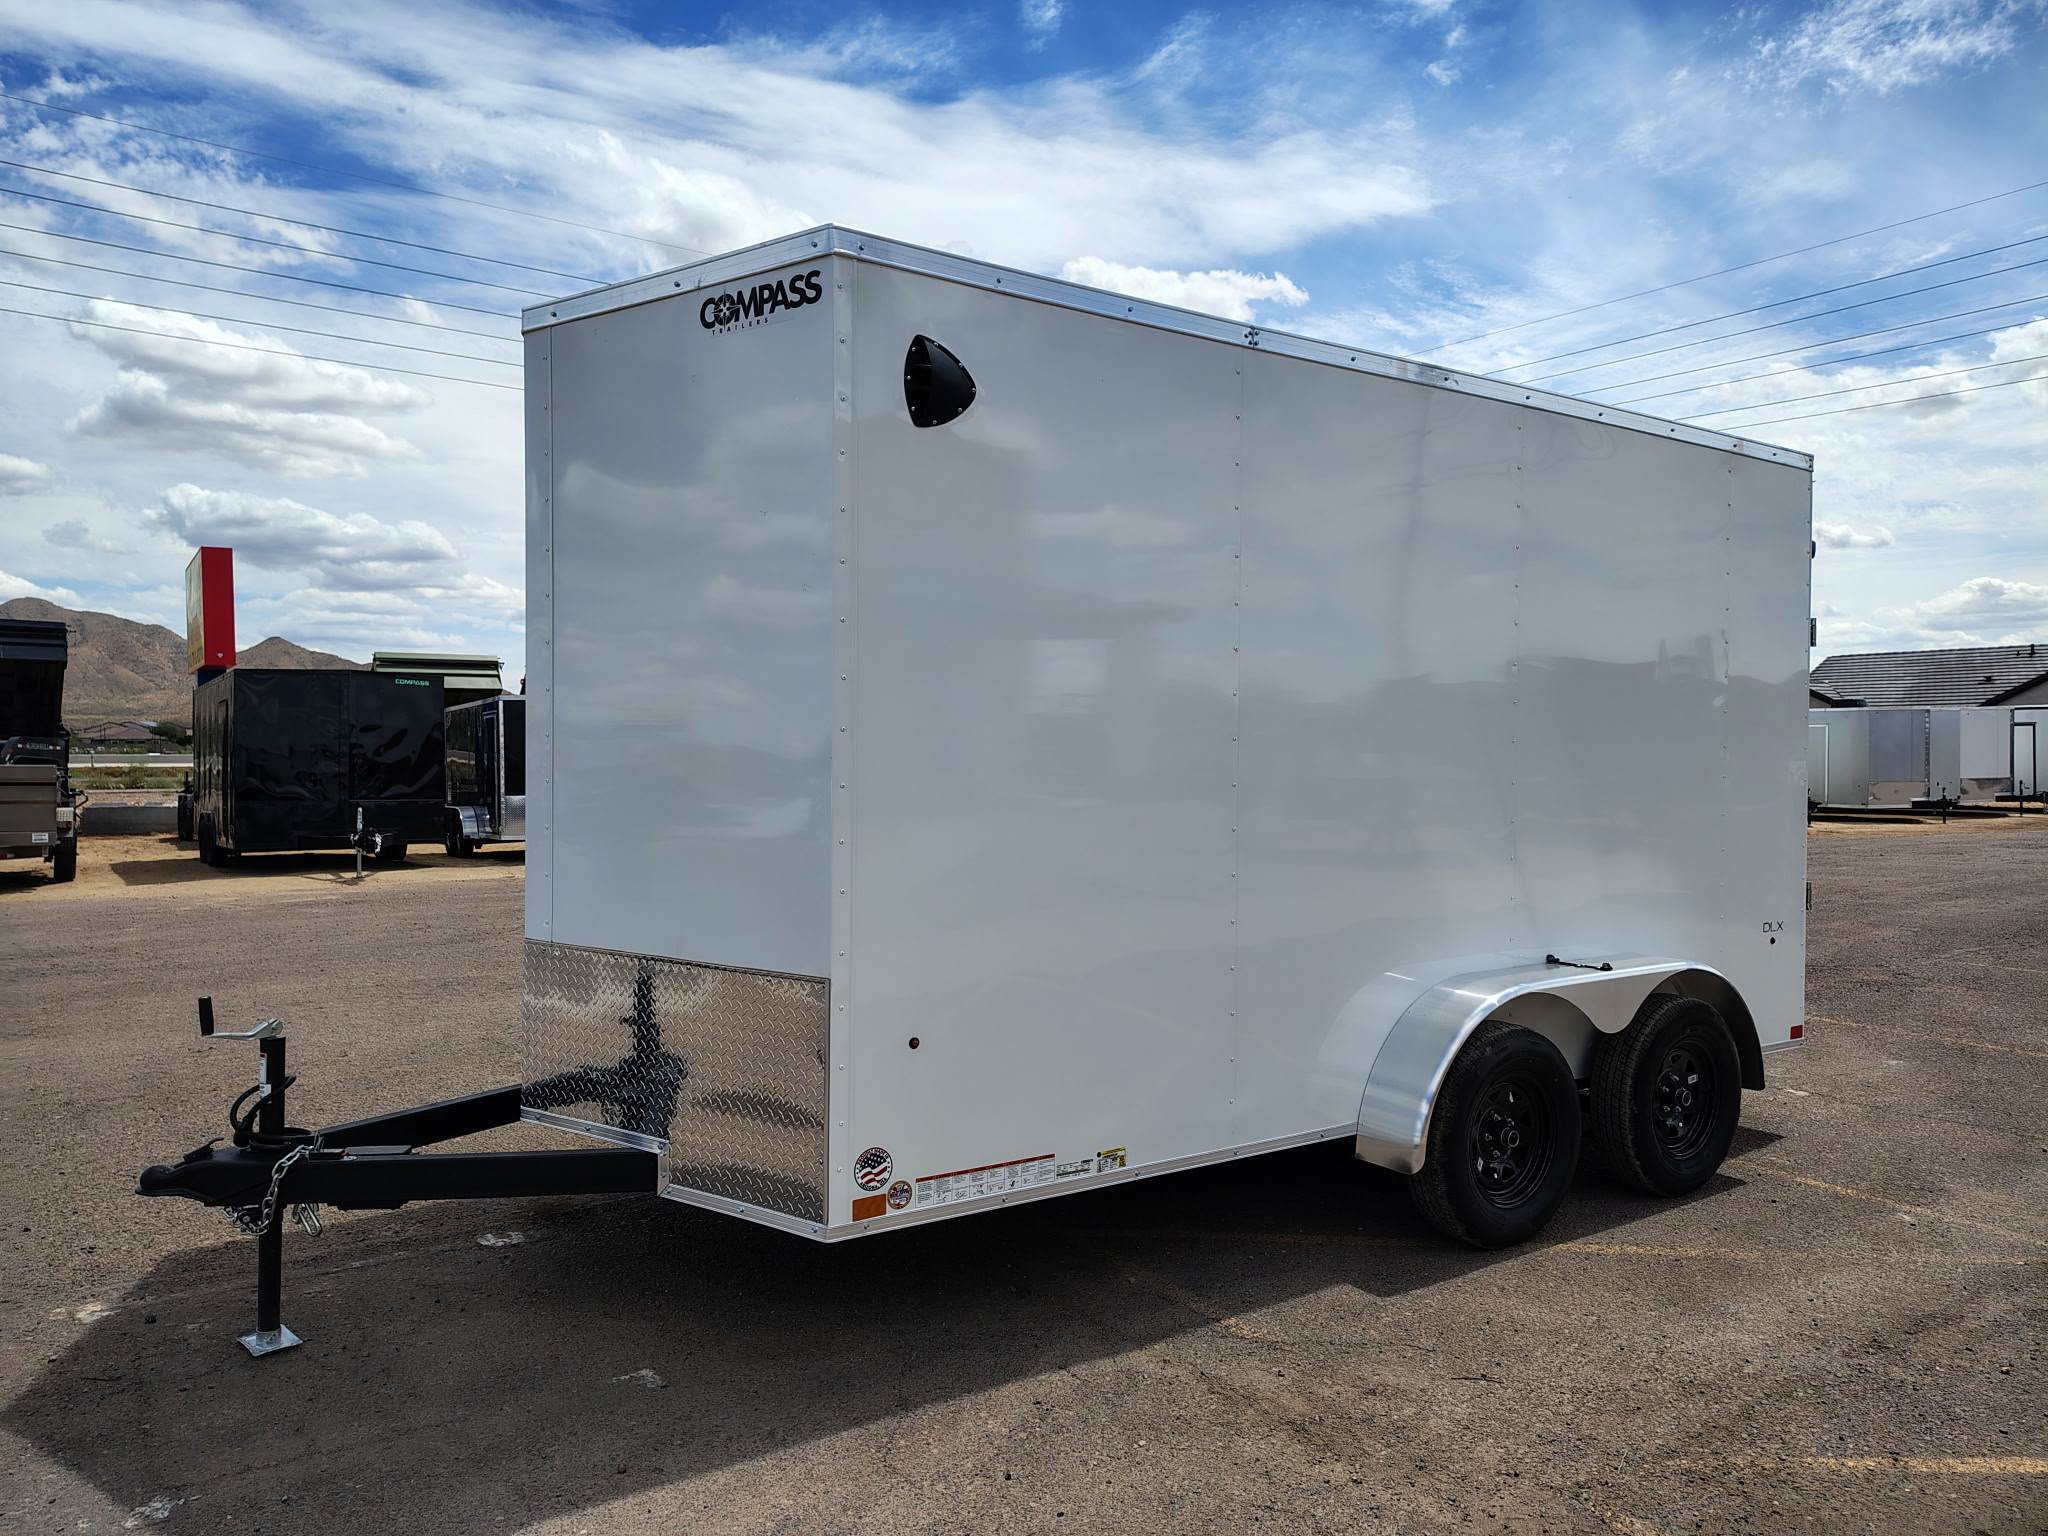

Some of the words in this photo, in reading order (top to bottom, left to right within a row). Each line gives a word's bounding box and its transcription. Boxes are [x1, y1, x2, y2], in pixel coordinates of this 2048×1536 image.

[700, 270, 822, 330] COMPASS
[712, 317, 769, 336] TRAILERS
[1763, 921, 1784, 932] DLX
